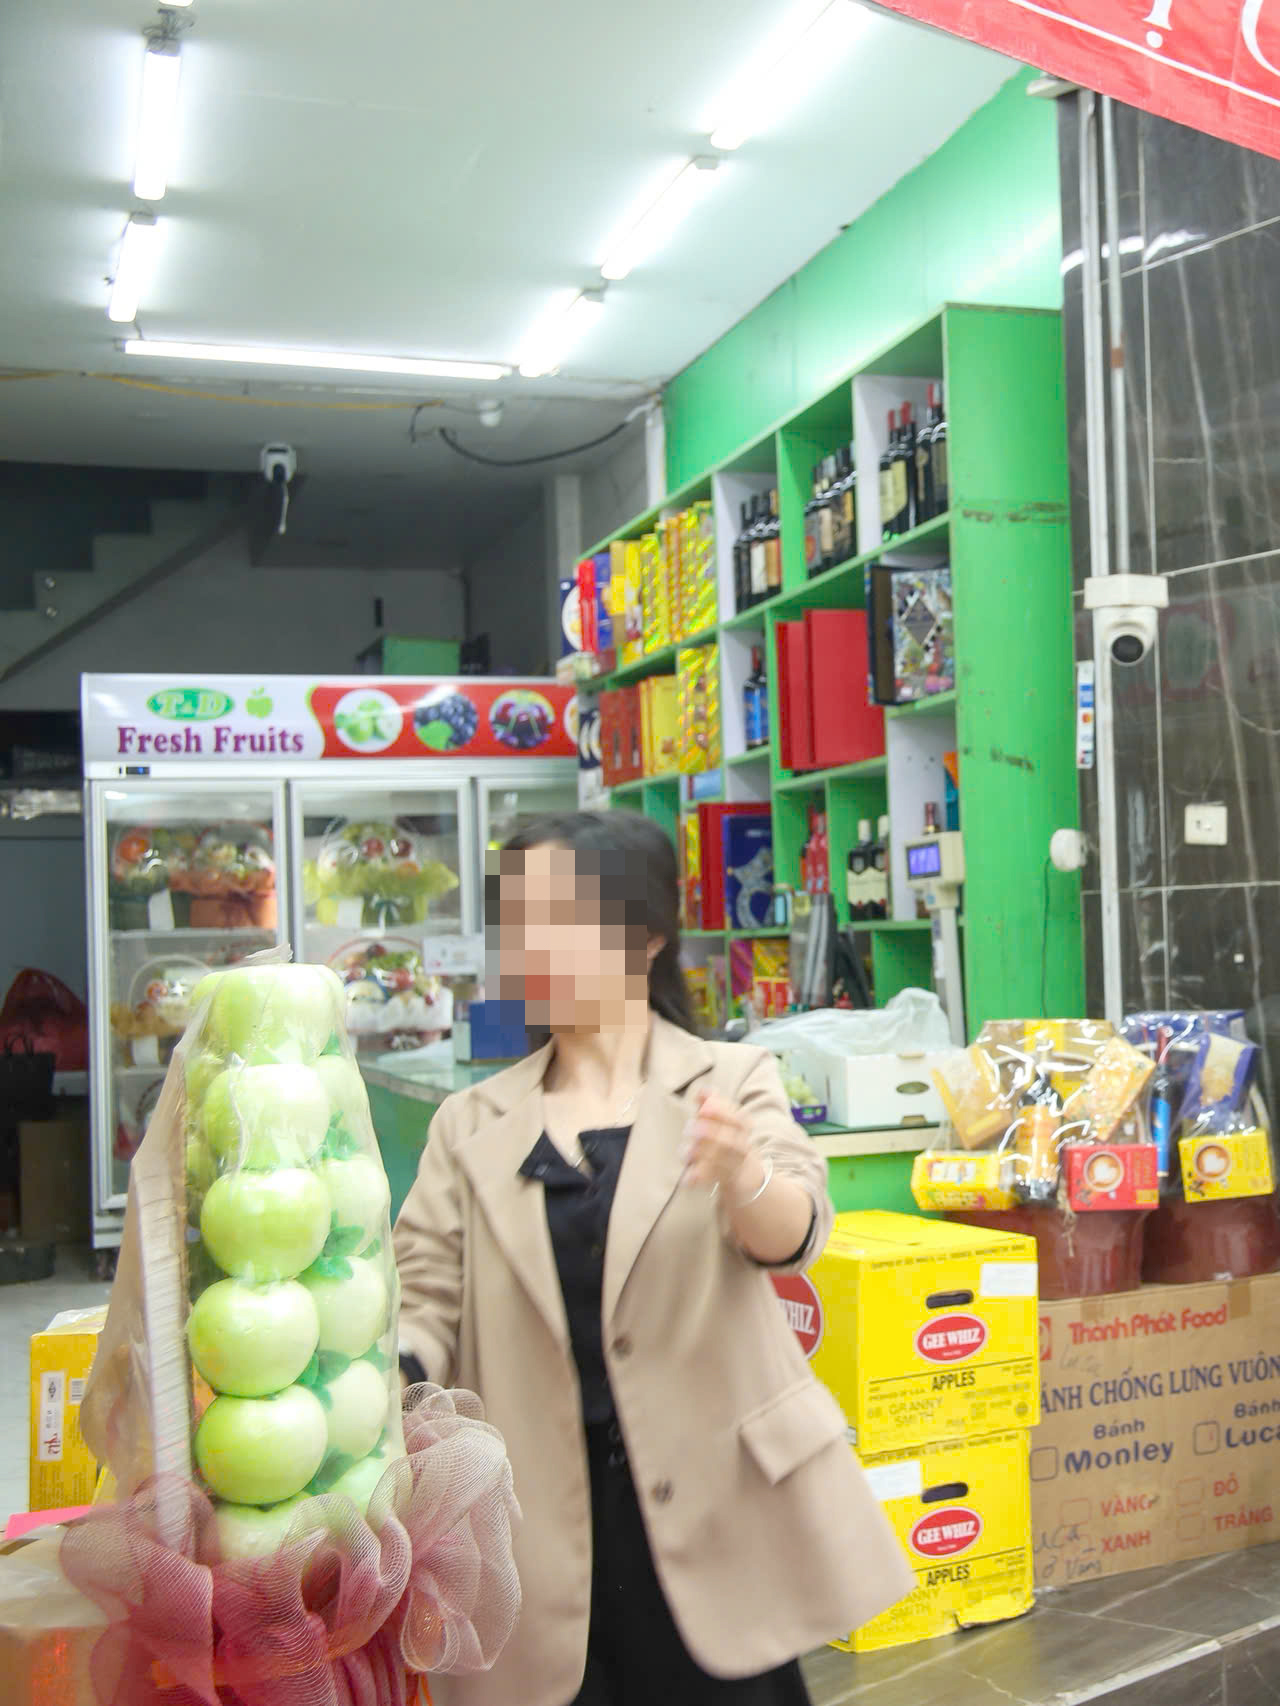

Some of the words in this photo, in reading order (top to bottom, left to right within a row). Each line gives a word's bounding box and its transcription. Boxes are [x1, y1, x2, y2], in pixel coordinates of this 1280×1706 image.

[117, 725, 203, 754] Fresh
[213, 725, 304, 754] Fruits
[1180, 1303, 1228, 1331] Food
[922, 1332, 947, 1350] GEE
[947, 1326, 981, 1346] WHIZ
[931, 1370, 976, 1391] APPLES
[1089, 1365, 1163, 1407] CHỐNG
[1093, 1418, 1145, 1441] Bánh
[1064, 1440, 1174, 1474] Monley
[917, 1528, 941, 1545] GEE
[941, 1520, 976, 1540] WHIZ
[1101, 1530, 1151, 1553] XANH
[925, 1564, 970, 1587] APPLES
